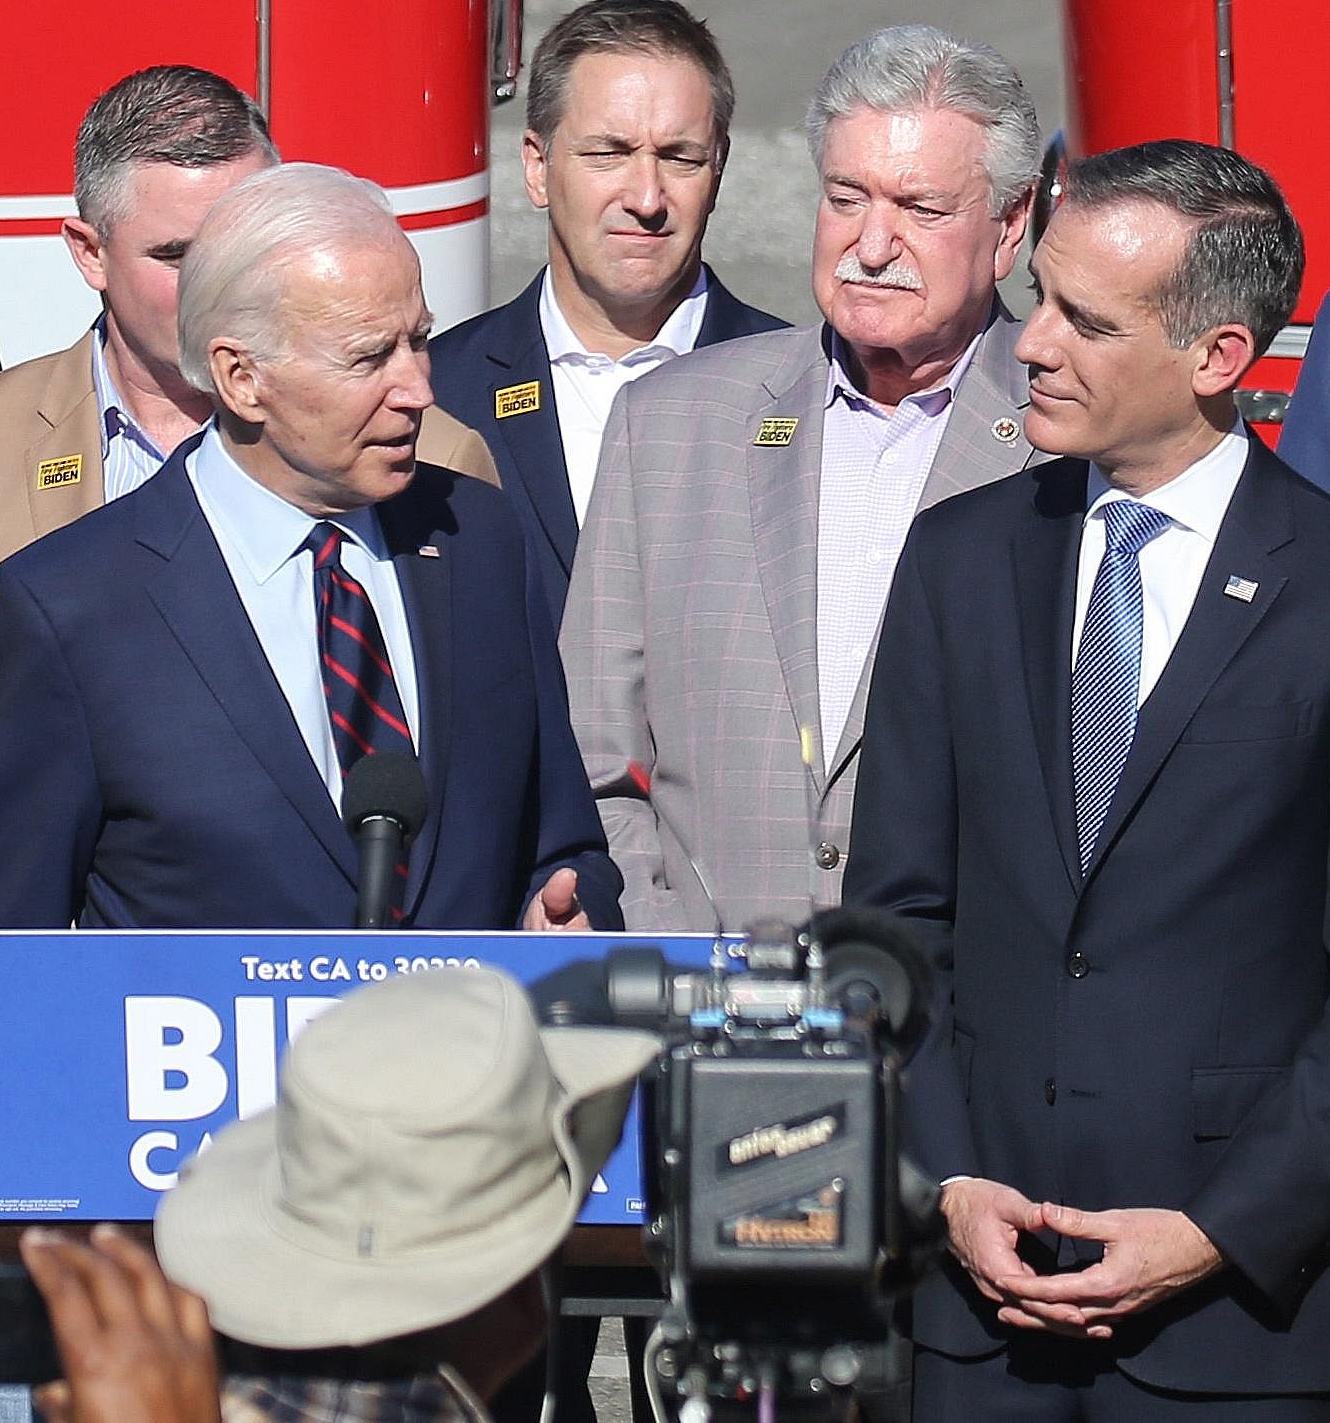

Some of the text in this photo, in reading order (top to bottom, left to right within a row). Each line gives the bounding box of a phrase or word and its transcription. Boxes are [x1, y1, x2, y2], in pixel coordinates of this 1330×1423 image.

[503, 397, 536, 414] BIDEN
[44, 469, 79, 486] BIDEN
[241, 956, 303, 981] Text
[309, 957, 351, 981] CA
[356, 958, 388, 982] to
